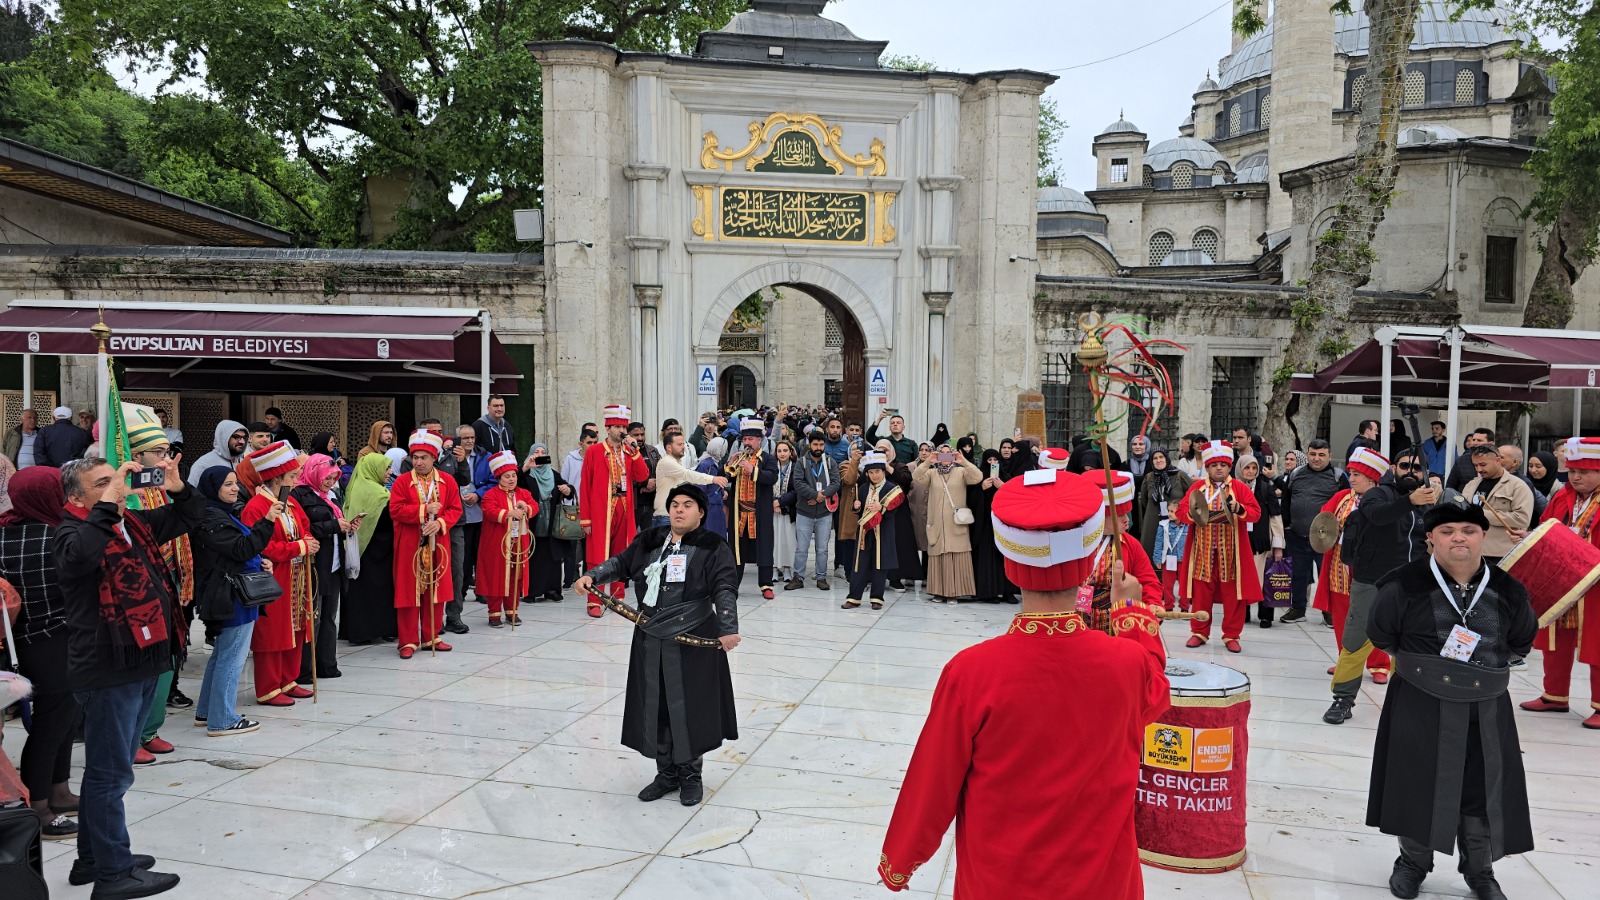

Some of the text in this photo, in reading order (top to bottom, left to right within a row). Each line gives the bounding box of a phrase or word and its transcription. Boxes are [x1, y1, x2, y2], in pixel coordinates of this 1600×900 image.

[109, 336, 309, 354] EYÜPSULTAN BELEDİYESİ
[701, 367, 715, 381] A
[872, 369, 885, 383] A
[1158, 747, 1178, 755] KONYA
[1197, 744, 1231, 755] ENDEM
[1148, 751, 1188, 763] BÜYÜKŞEHİR
[1152, 773, 1229, 794] GENÇLER
[1173, 795, 1233, 812] TAKIMI
